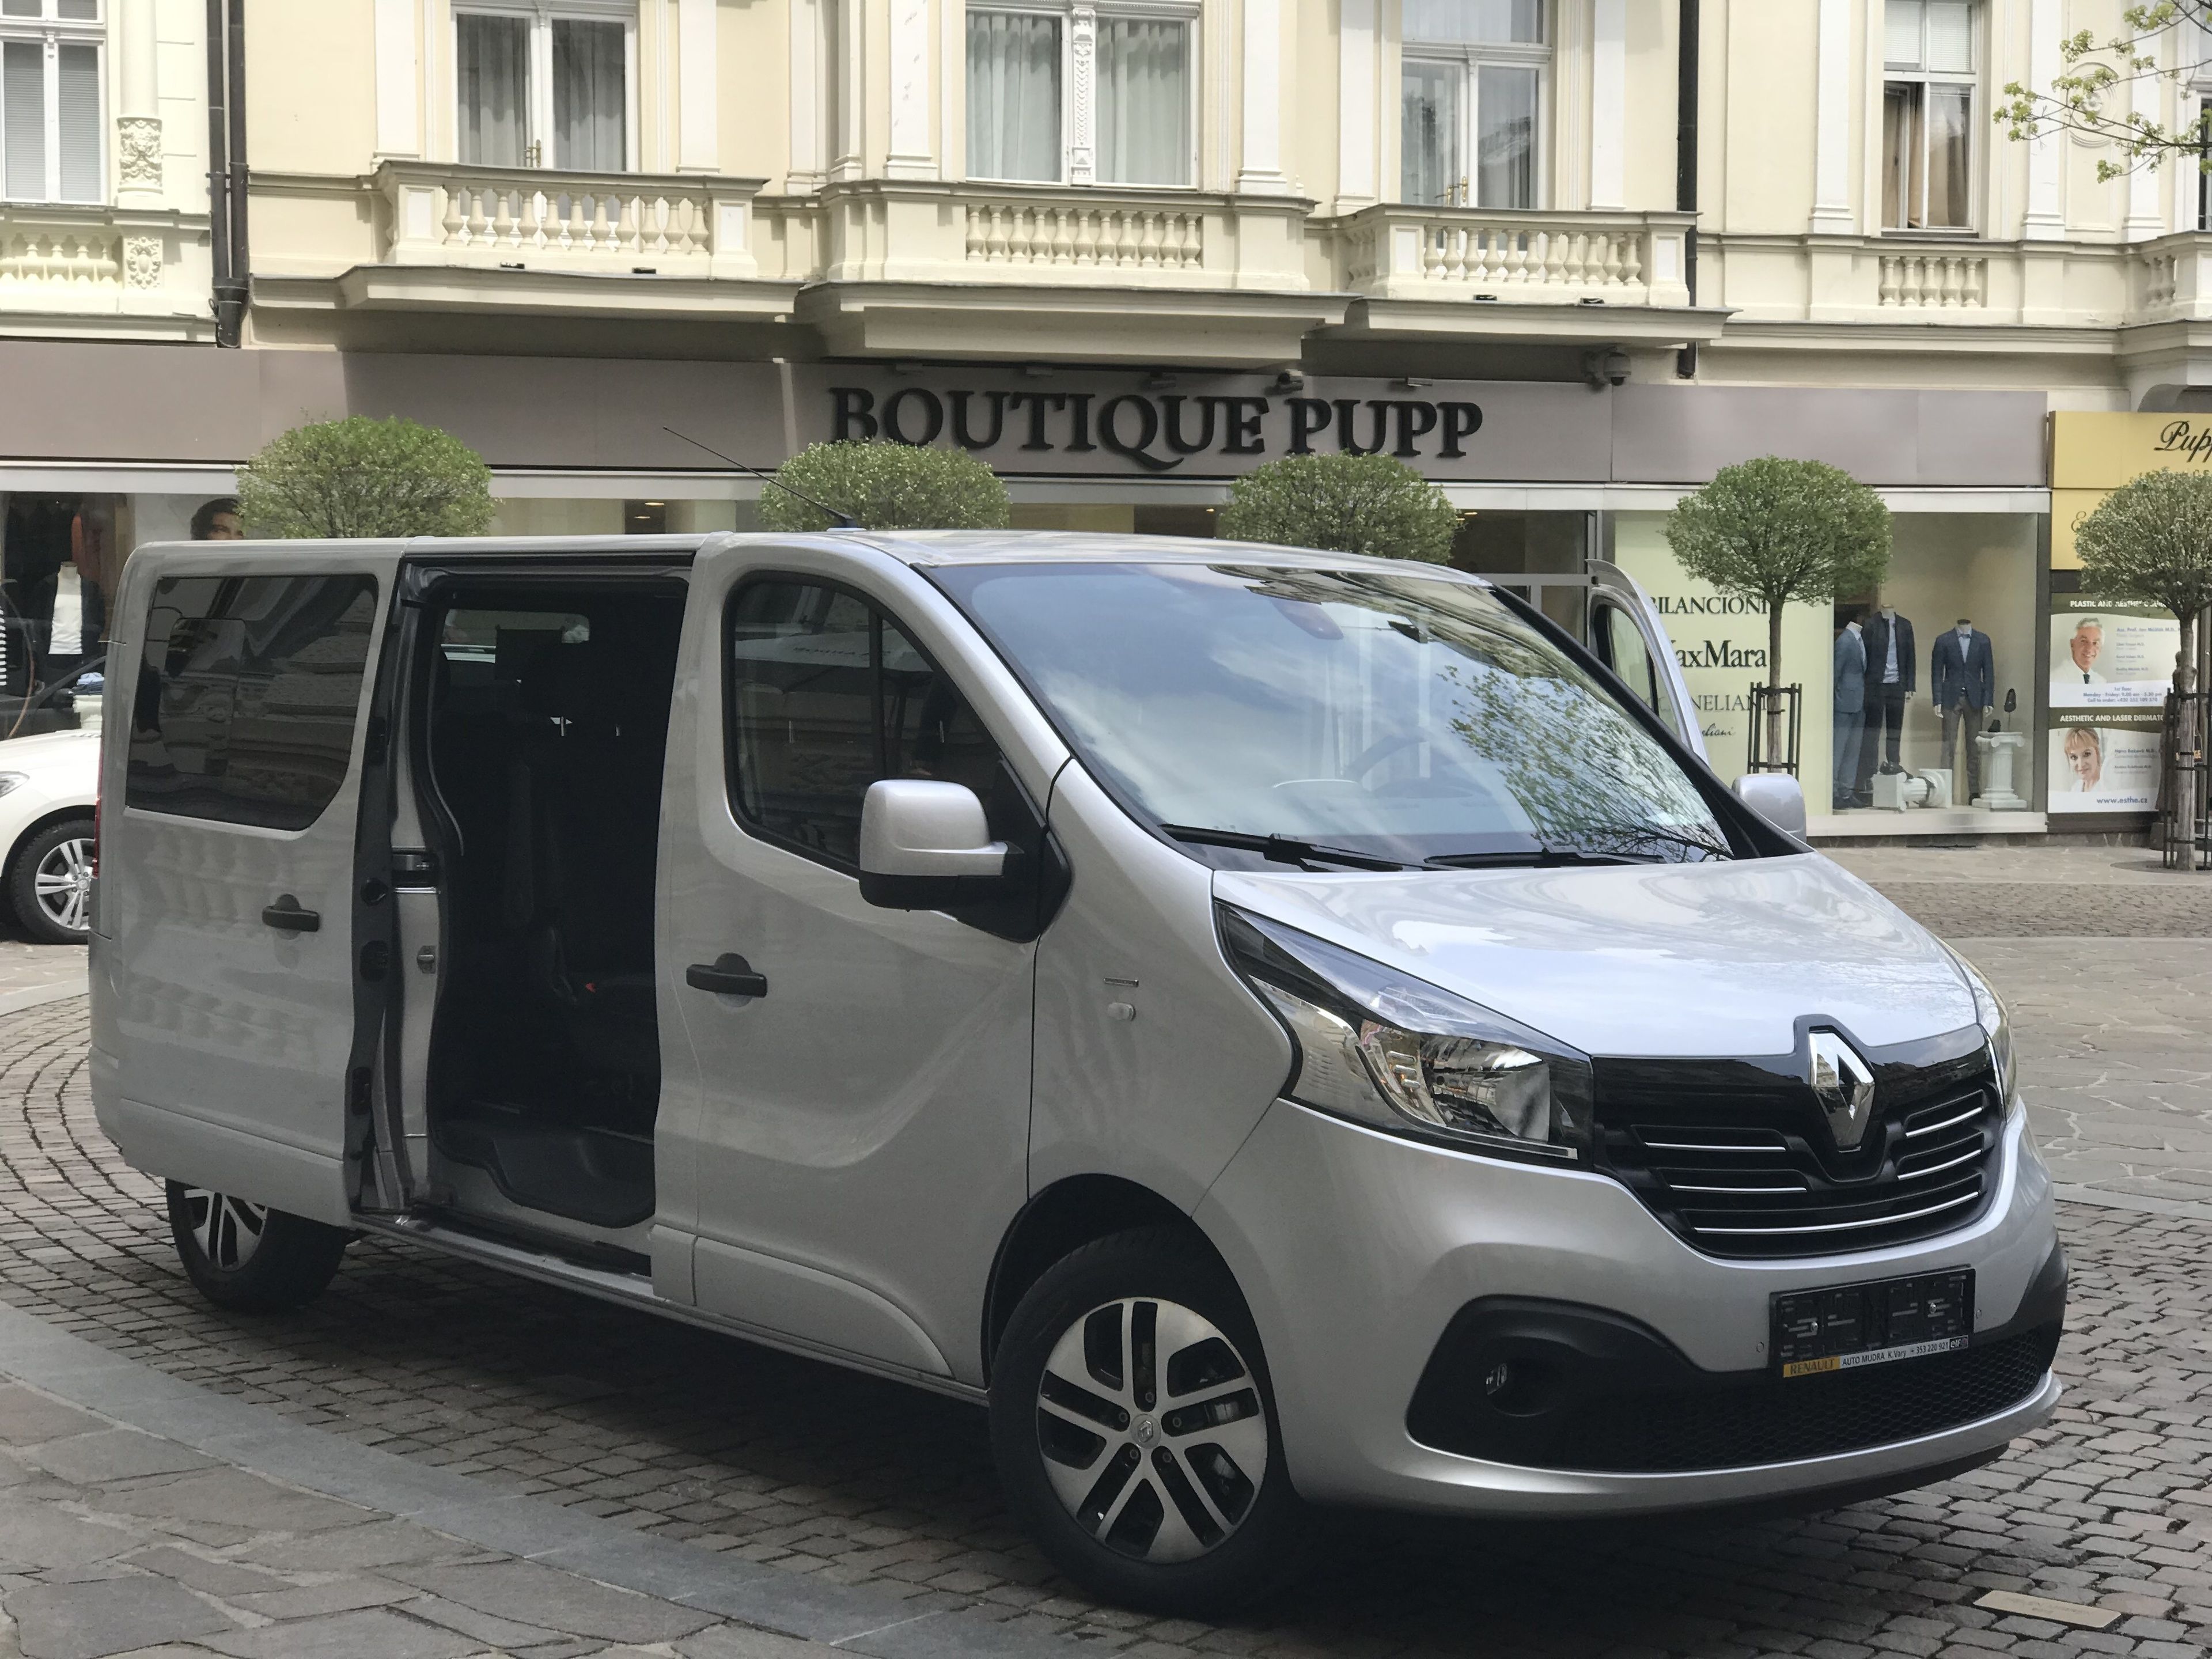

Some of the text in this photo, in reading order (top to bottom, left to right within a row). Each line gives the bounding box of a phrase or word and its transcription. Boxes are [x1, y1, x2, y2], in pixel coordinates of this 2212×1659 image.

[830, 386, 1483, 470] BOUTIQUE PUPP
[1670, 640, 1767, 668] axMara
[1790, 1358, 1835, 1375] RENAULT
[1843, 1355, 1860, 1366] AUTO
[1861, 1353, 1885, 1363] MUDRA
